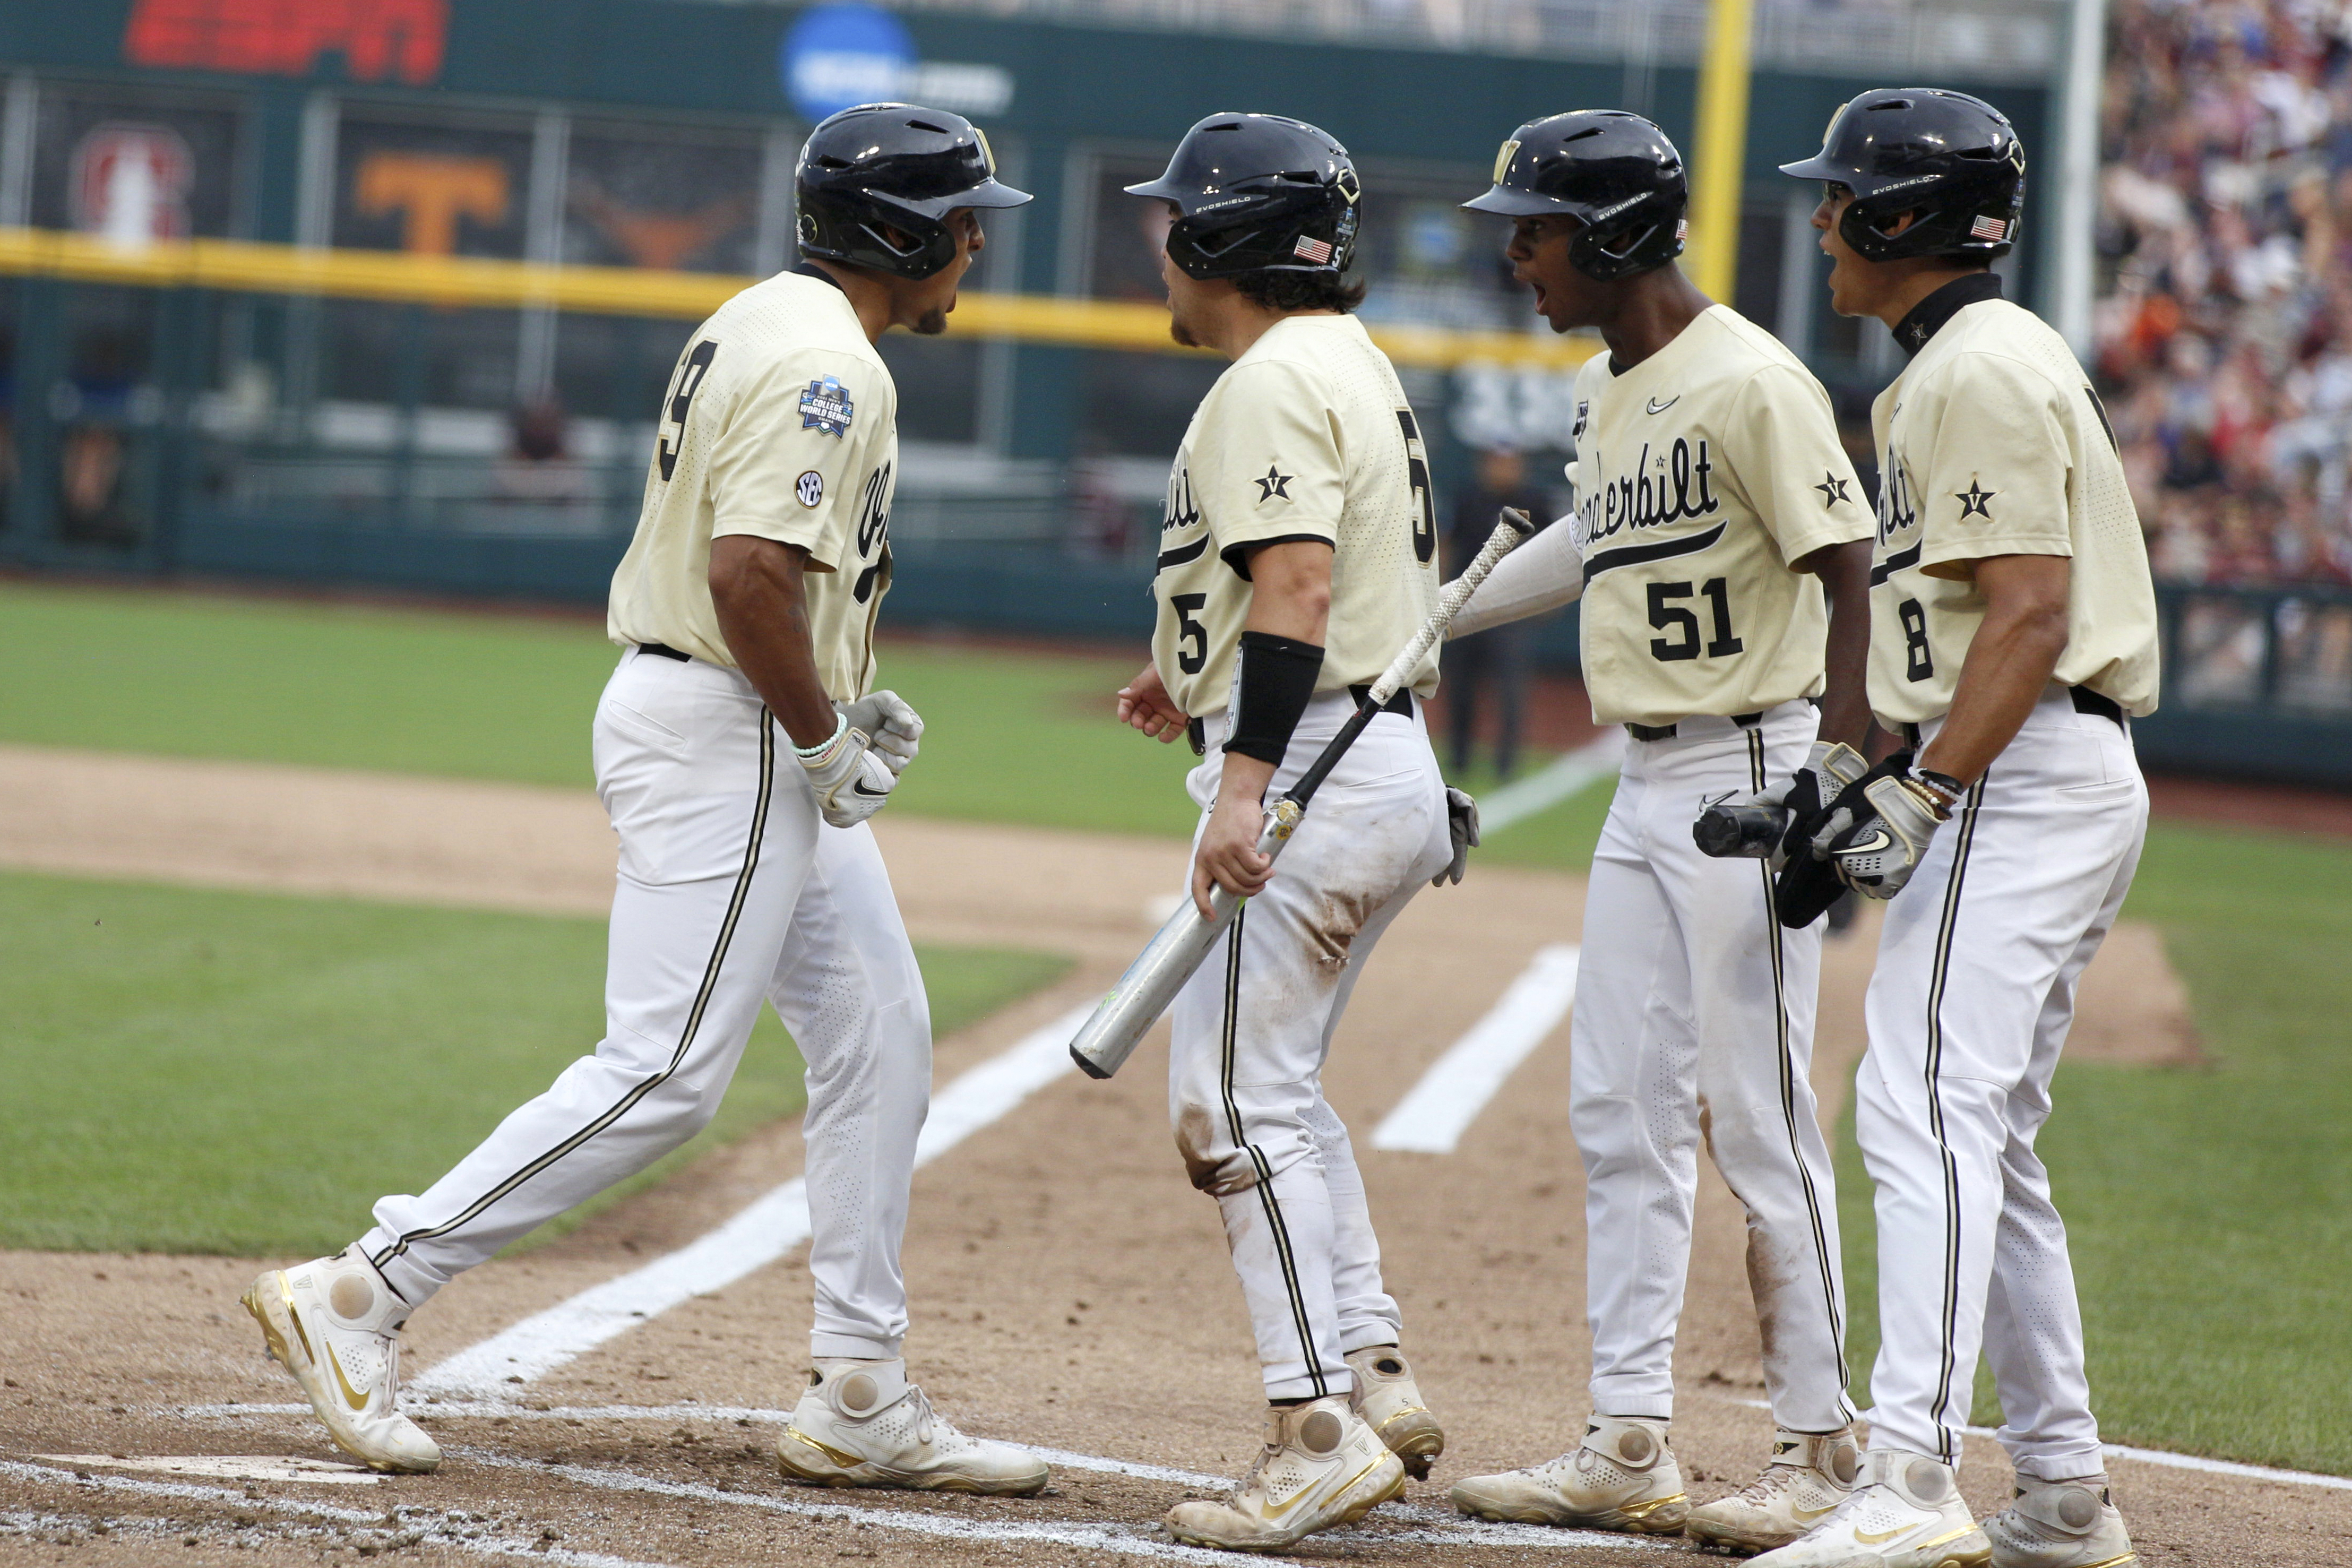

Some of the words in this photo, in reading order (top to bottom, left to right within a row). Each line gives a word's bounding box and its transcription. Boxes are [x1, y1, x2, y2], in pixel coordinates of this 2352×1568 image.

[1872, 176, 1929, 195] EVOSHIELD
[1195, 196, 1251, 213] EVOSHIELD
[1599, 192, 1647, 220] EVOSHIELD
[1332, 246, 1344, 268] 5
[800, 404, 828, 417] WORLD
[827, 411, 851, 425] SERIES
[812, 398, 843, 413] COLLEGE
[797, 471, 823, 506] SEC
[1266, 477, 1280, 493] V
[1396, 411, 1435, 564] 5
[1827, 482, 1839, 497] V
[1967, 493, 1982, 510] V
[1646, 576, 1744, 662] 51
[1170, 592, 1208, 675] 5
[1898, 597, 1934, 683] 8
[1402, 1398, 1409, 1407] 5
